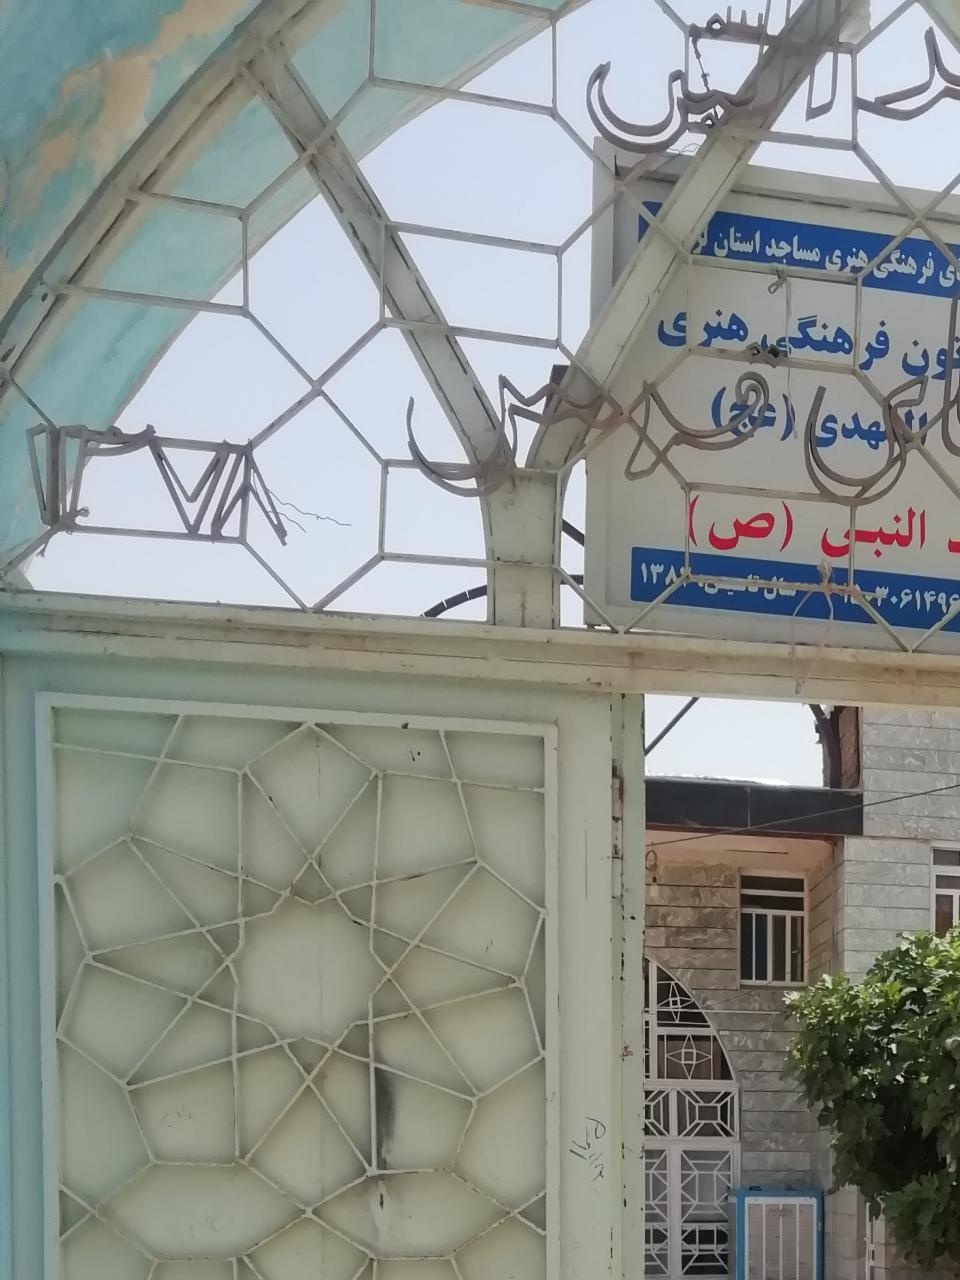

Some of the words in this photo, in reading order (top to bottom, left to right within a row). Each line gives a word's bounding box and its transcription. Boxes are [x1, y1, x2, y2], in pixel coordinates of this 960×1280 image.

[713, 226, 761, 257] استان
[765, 234, 821, 264] مساجد
[825, 246, 870, 272] هنری
[873, 248, 934, 284] فرهنگی
[657, 308, 749, 348] هنری
[688, 495, 793, 552] (ص)
[820, 506, 926, 558] النبی
